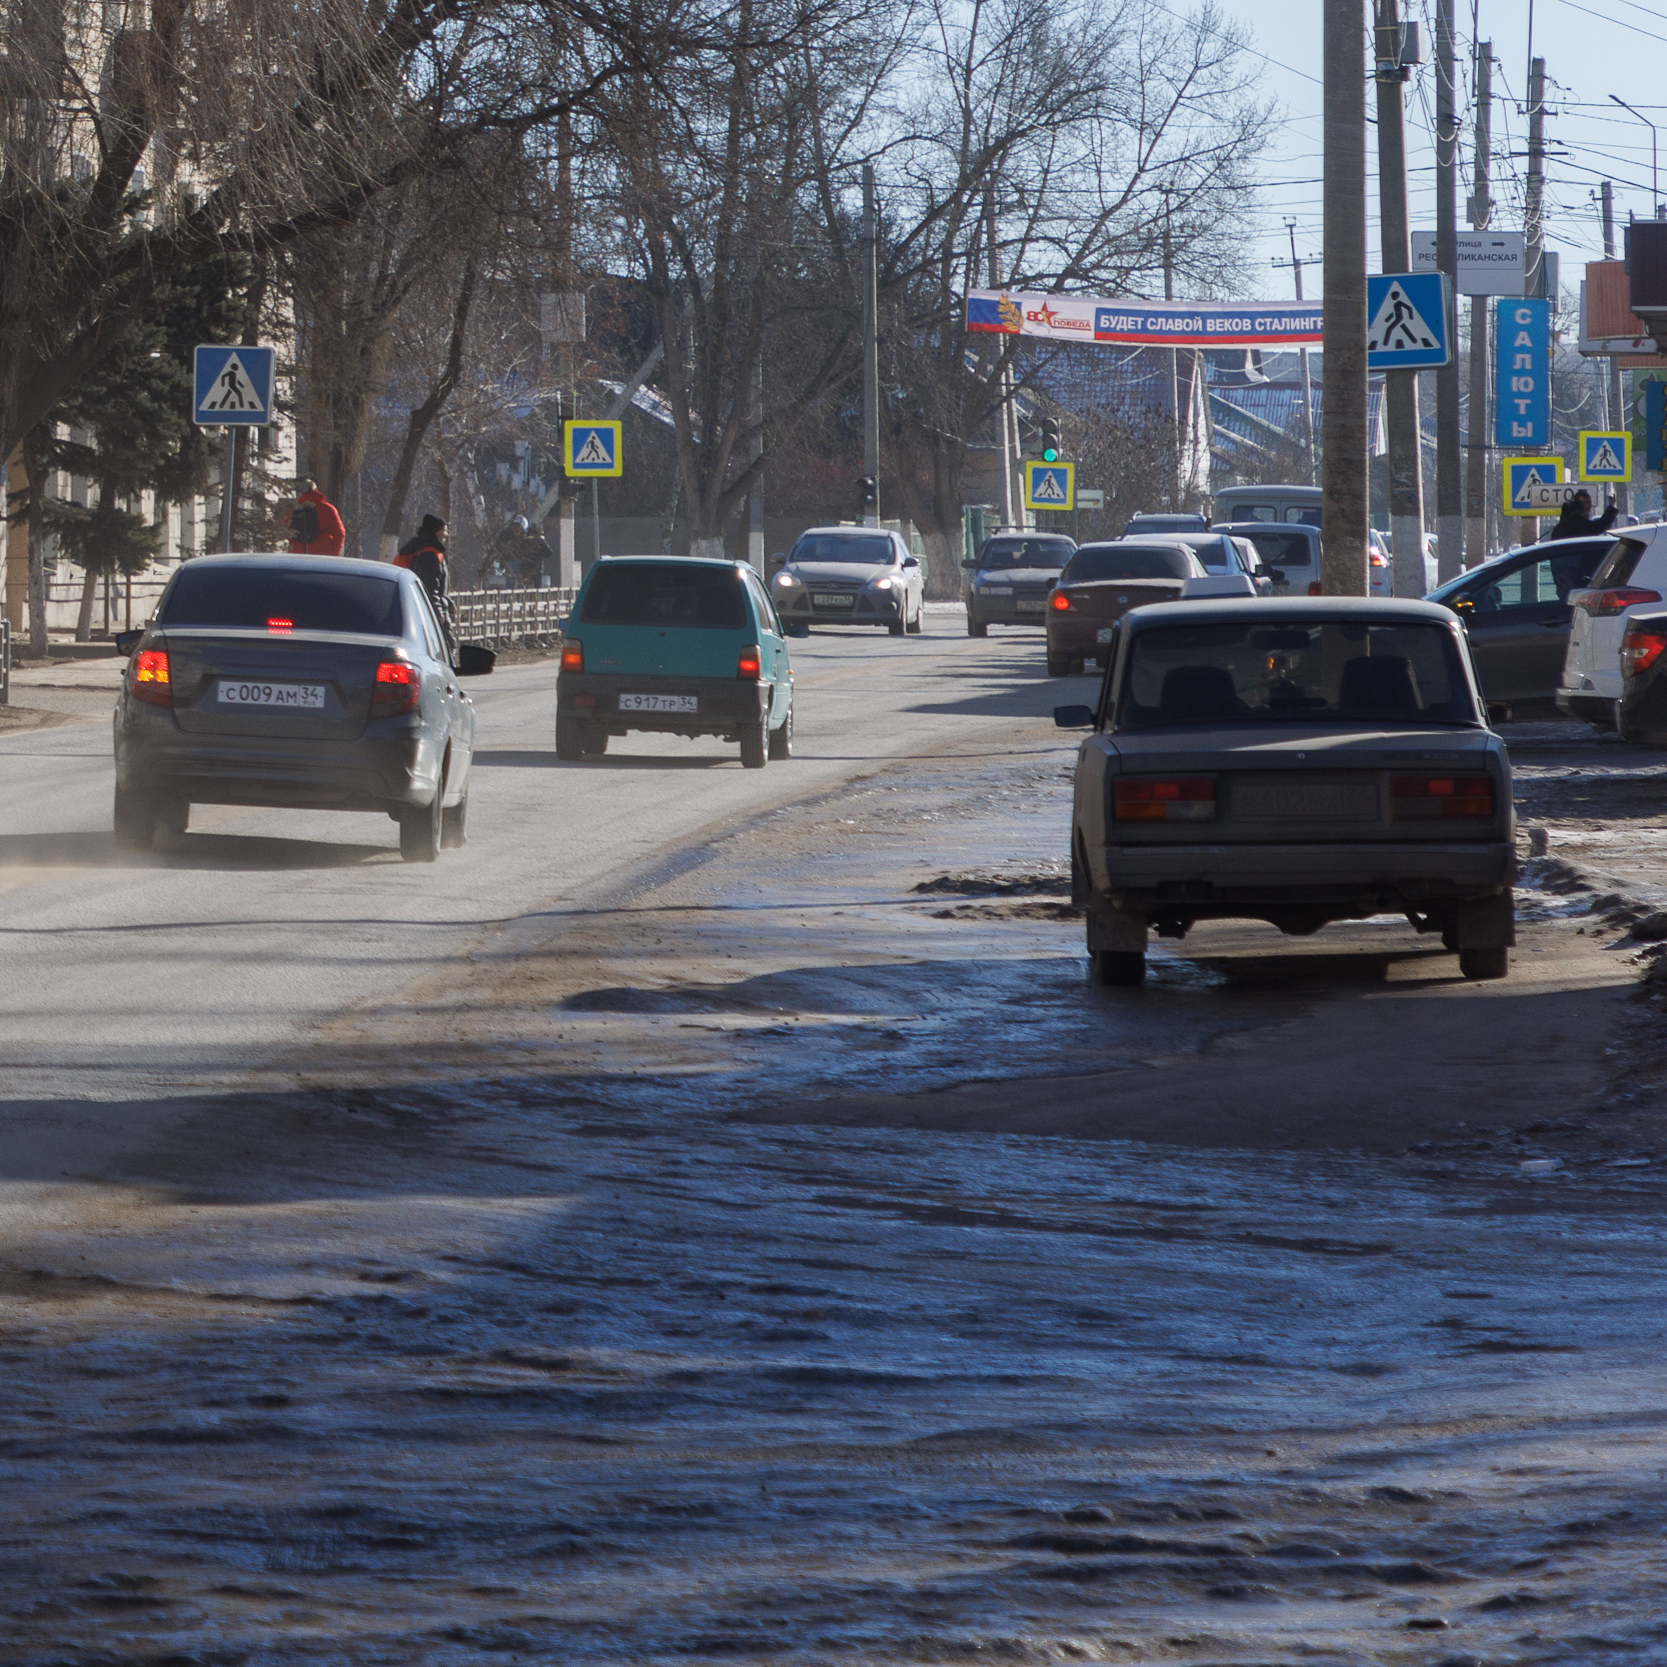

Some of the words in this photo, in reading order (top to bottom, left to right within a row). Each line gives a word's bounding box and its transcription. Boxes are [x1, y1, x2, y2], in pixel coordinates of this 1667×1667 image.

[1456, 240, 1482, 249] лица
[1418, 253, 1518, 262] РЕСЛИКАНСКАЯ
[1053, 319, 1092, 329] ПОБЕДА
[1100, 315, 1145, 332] БУДЕТ
[1147, 316, 1203, 332] СЛАВОЙ
[1207, 318, 1252, 332] ВЕКОВ
[1512, 308, 1535, 438] САЛЮТЫ
[1540, 488, 1588, 502] СТО
[301, 686, 319, 700] 34
